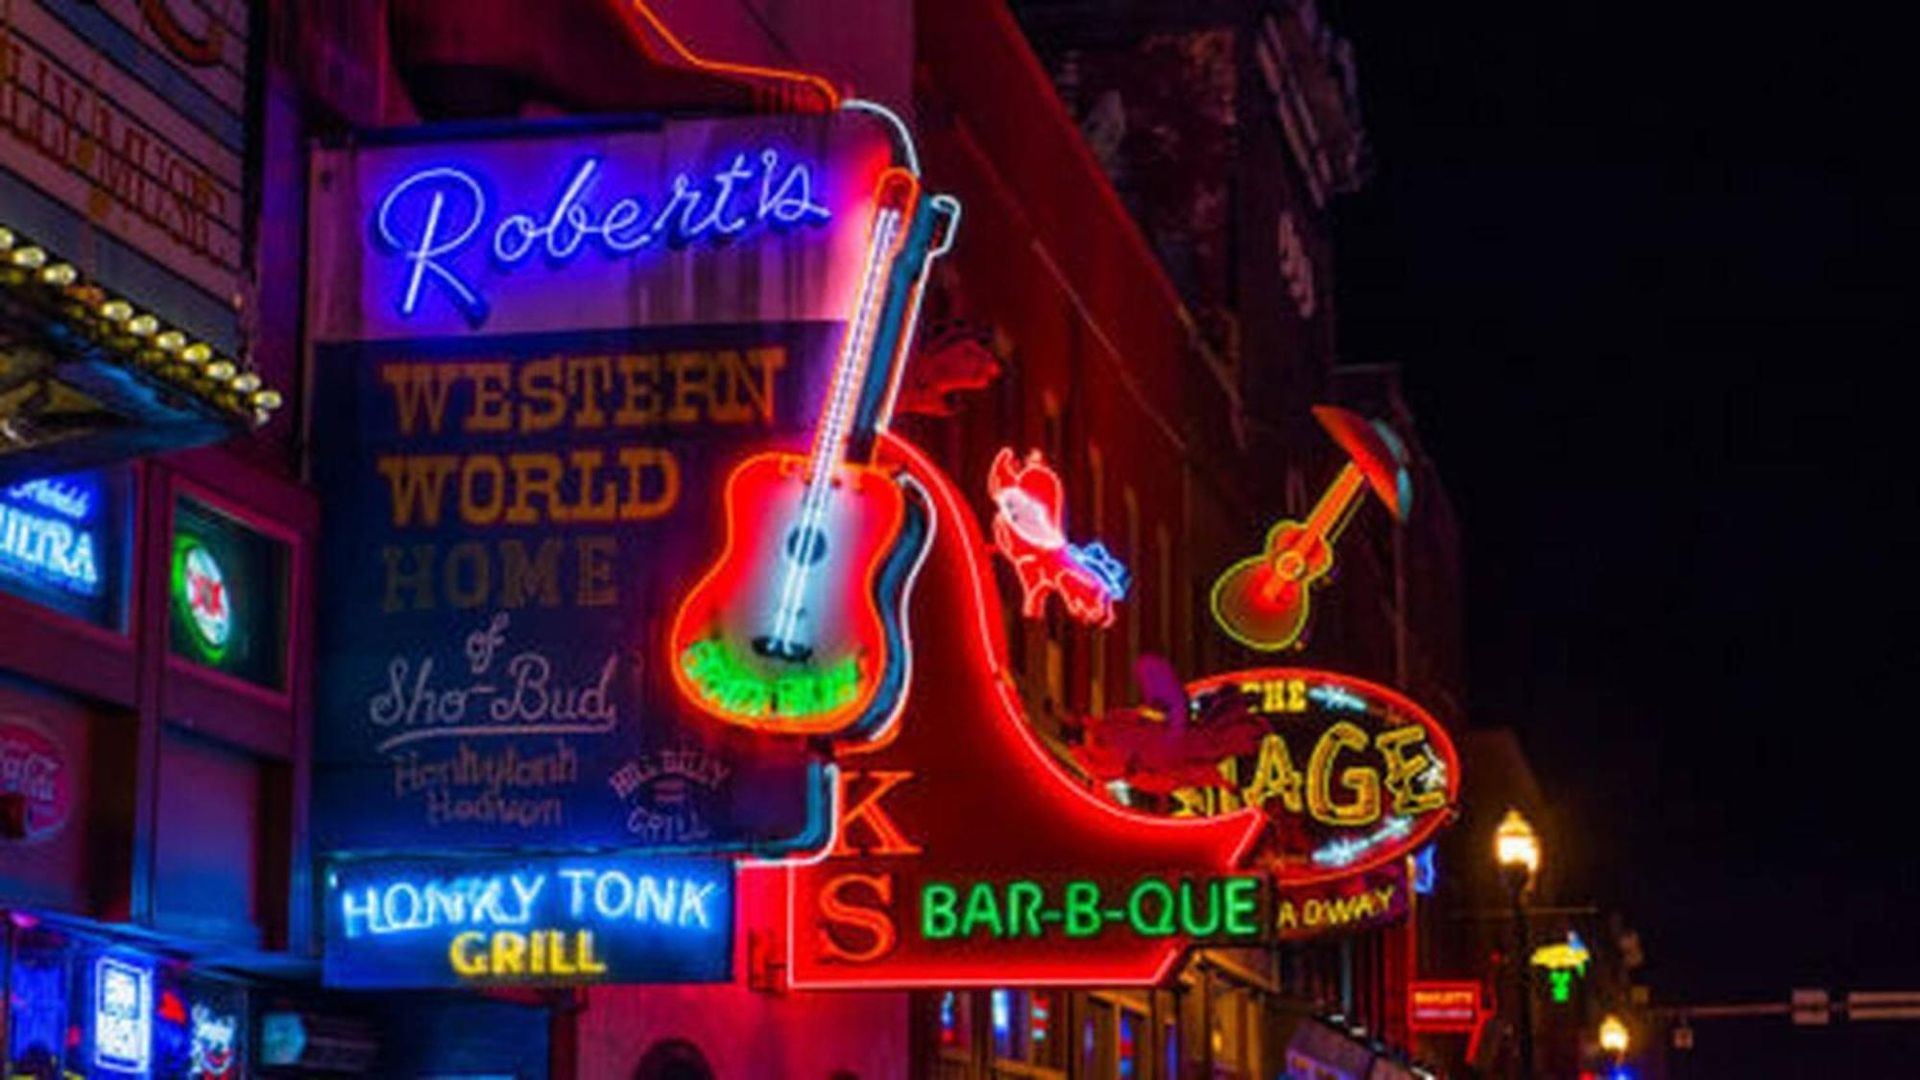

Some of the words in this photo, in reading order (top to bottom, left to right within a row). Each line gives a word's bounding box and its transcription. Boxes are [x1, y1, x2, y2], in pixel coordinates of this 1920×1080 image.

[378, 148, 832, 316] Robert's
[381, 347, 787, 434] WESTERN
[377, 446, 681, 526] WORLD
[382, 537, 618, 613] HOME
[466, 612, 509, 674] of
[369, 652, 617, 728] Sho-Bud
[660, 748, 733, 790] BILLY
[1170, 721, 1446, 826] AGE
[626, 804, 711, 843] GRILL
[343, 874, 546, 938] HONKY
[559, 869, 718, 928] TONK
[920, 876, 1258, 939] BAR-B-QUE
[448, 929, 607, 976] GRILL
